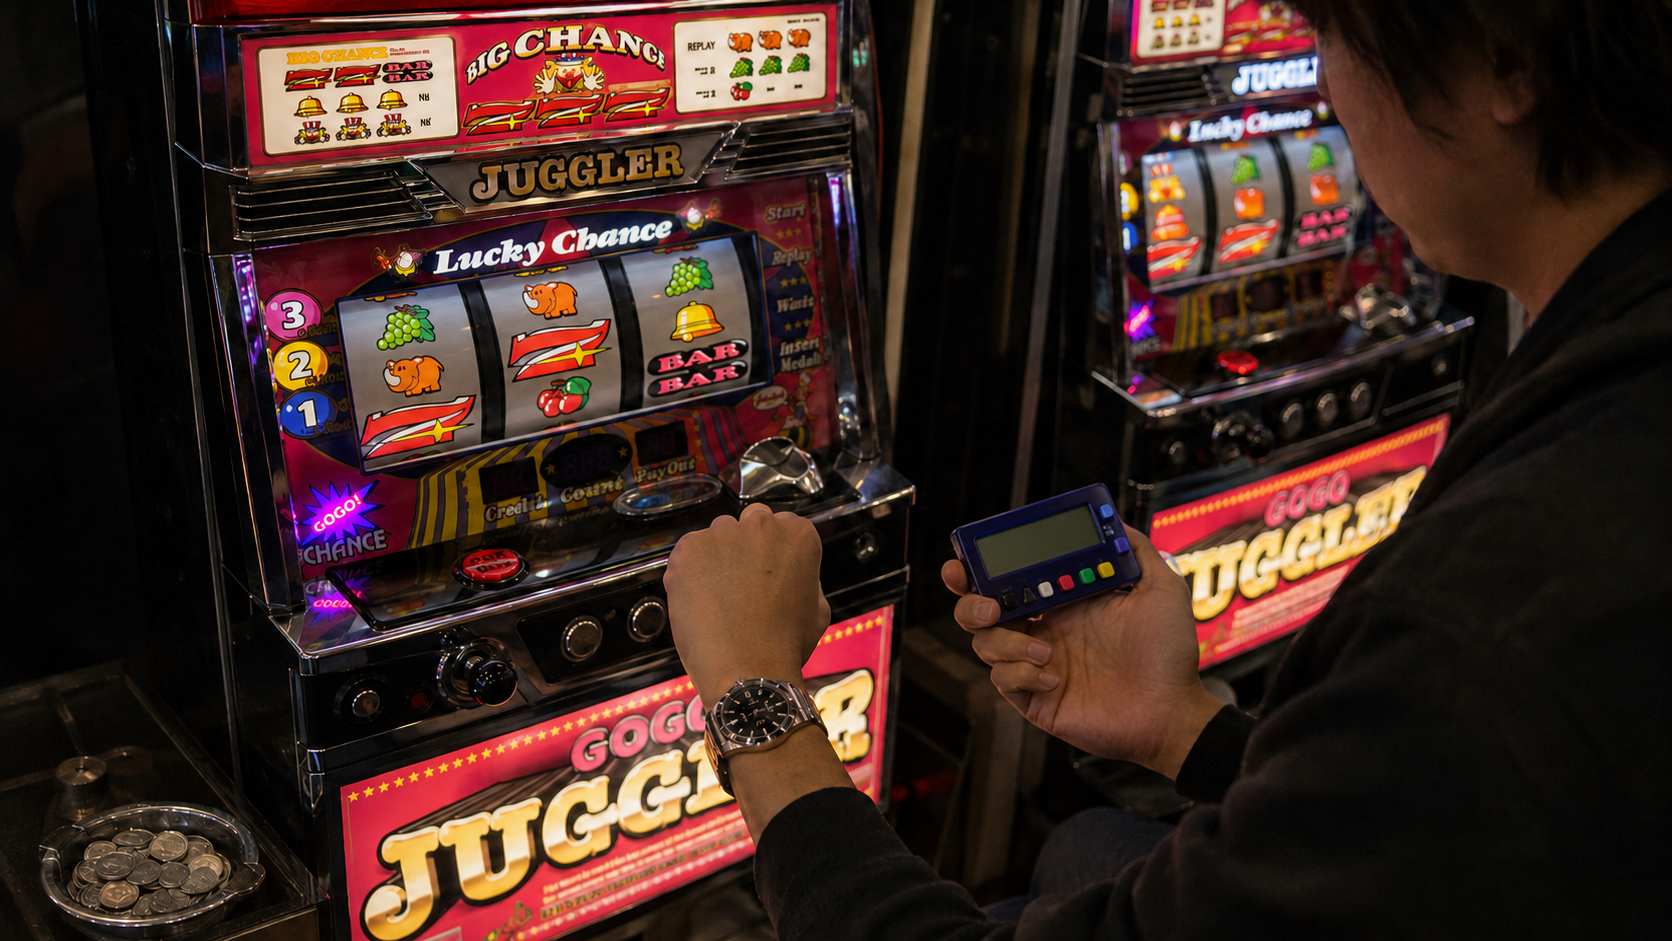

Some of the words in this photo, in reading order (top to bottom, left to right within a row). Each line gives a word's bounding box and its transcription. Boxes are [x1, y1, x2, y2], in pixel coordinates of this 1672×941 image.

[466, 41, 511, 85] BIG
[514, 24, 666, 71] CHANCE
[687, 41, 716, 52] REPLAY
[472, 145, 684, 200] JUGGLER
[766, 202, 807, 221] Start
[433, 238, 545, 275] Lucky
[551, 220, 673, 254] Chance
[771, 247, 812, 266] Replay
[281, 300, 305, 330] 3
[657, 343, 740, 373] BAR
[780, 337, 820, 356] Insert
[288, 350, 313, 380] 2
[657, 365, 739, 395] BAR
[297, 398, 317, 428] 1
[314, 493, 362, 532] GOGO!
[1264, 469, 1350, 528] GOGO
[303, 529, 388, 565] CHANCE
[364, 668, 874, 941] JUGGLR
